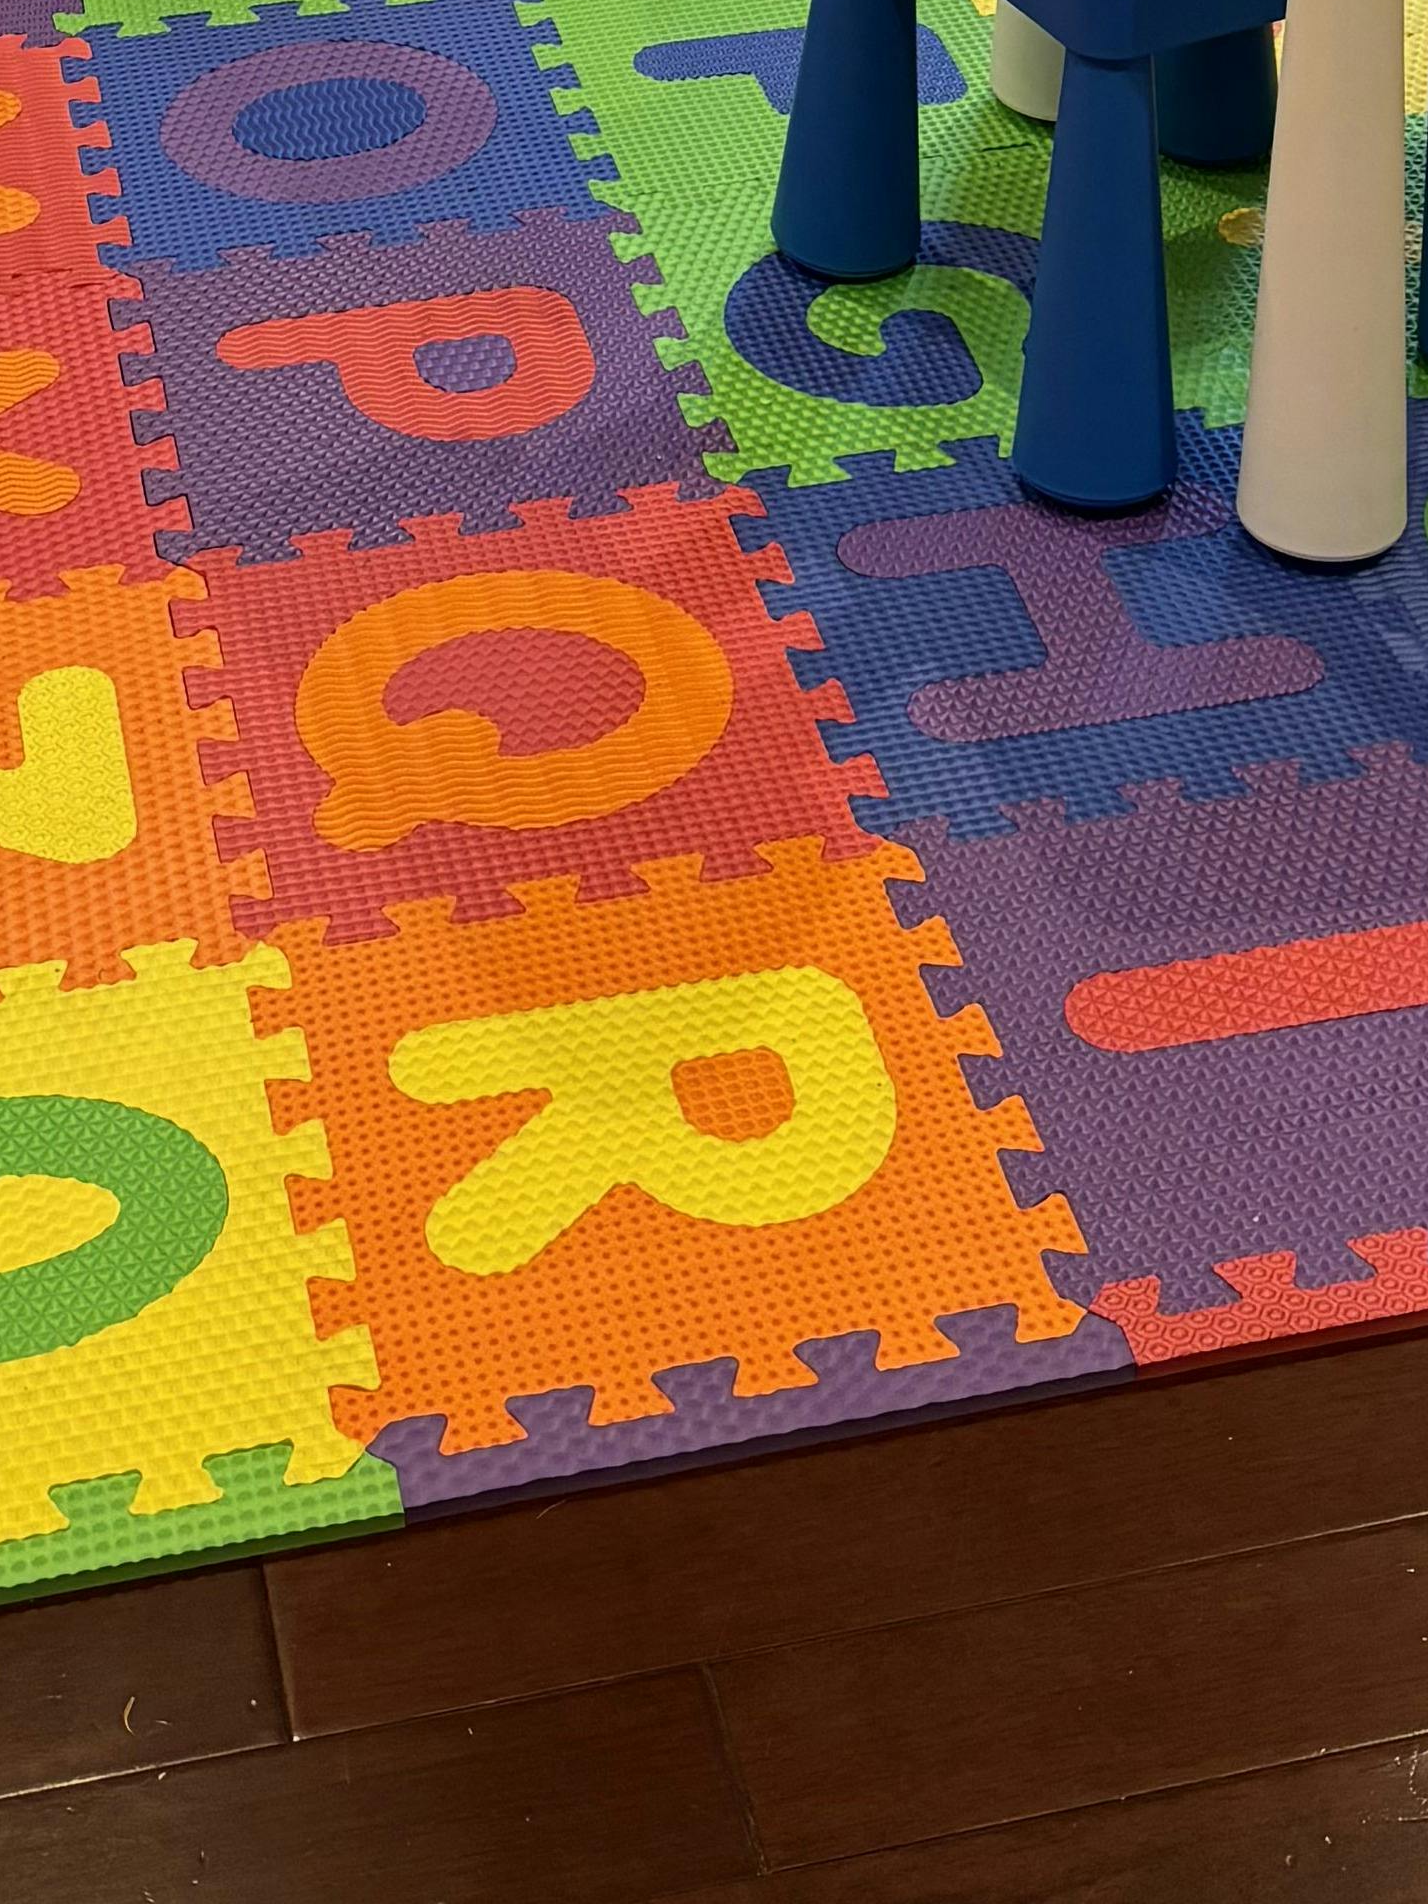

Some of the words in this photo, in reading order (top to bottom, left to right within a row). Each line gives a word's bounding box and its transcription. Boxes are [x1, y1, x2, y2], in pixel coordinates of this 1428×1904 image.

[215, 285, 598, 442] P
[294, 569, 735, 853] Q
[833, 485, 1326, 745] H
[386, 964, 898, 1276] R
